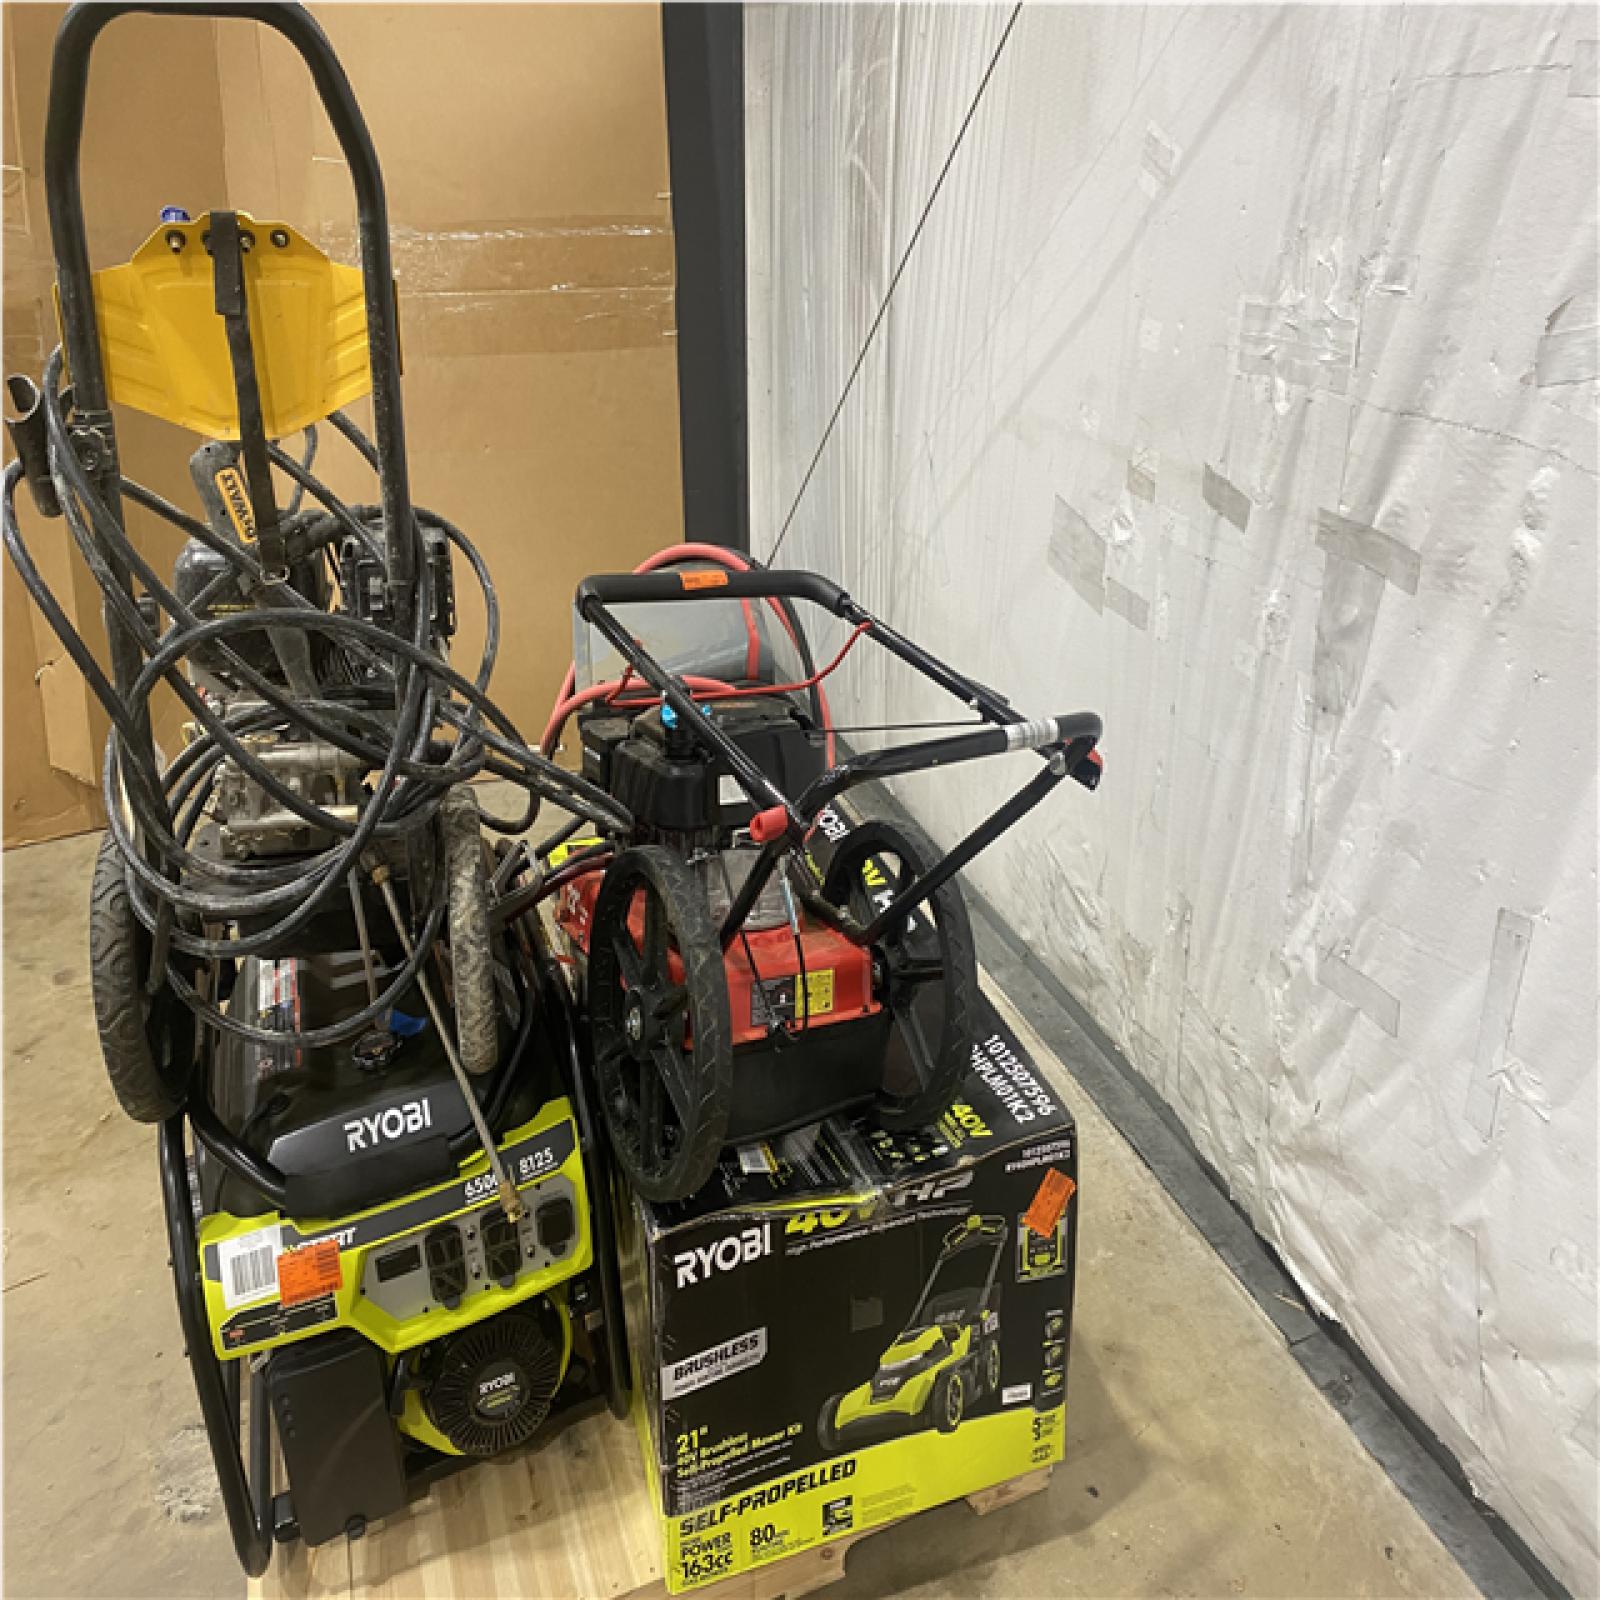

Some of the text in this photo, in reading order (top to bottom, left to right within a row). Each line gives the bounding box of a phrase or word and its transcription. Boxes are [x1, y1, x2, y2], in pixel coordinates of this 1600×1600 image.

[816, 803, 851, 843] OBI
[343, 1097, 432, 1153] RYOBI
[519, 1146, 554, 1175] 8125
[674, 1220, 771, 1289] RYOBI
[674, 1334, 759, 1381] BRUSHLESS
[479, 1371, 516, 1395] RYOBI
[679, 1459, 856, 1537] SELF-PROPELLED
[749, 1523, 776, 1546] 80
